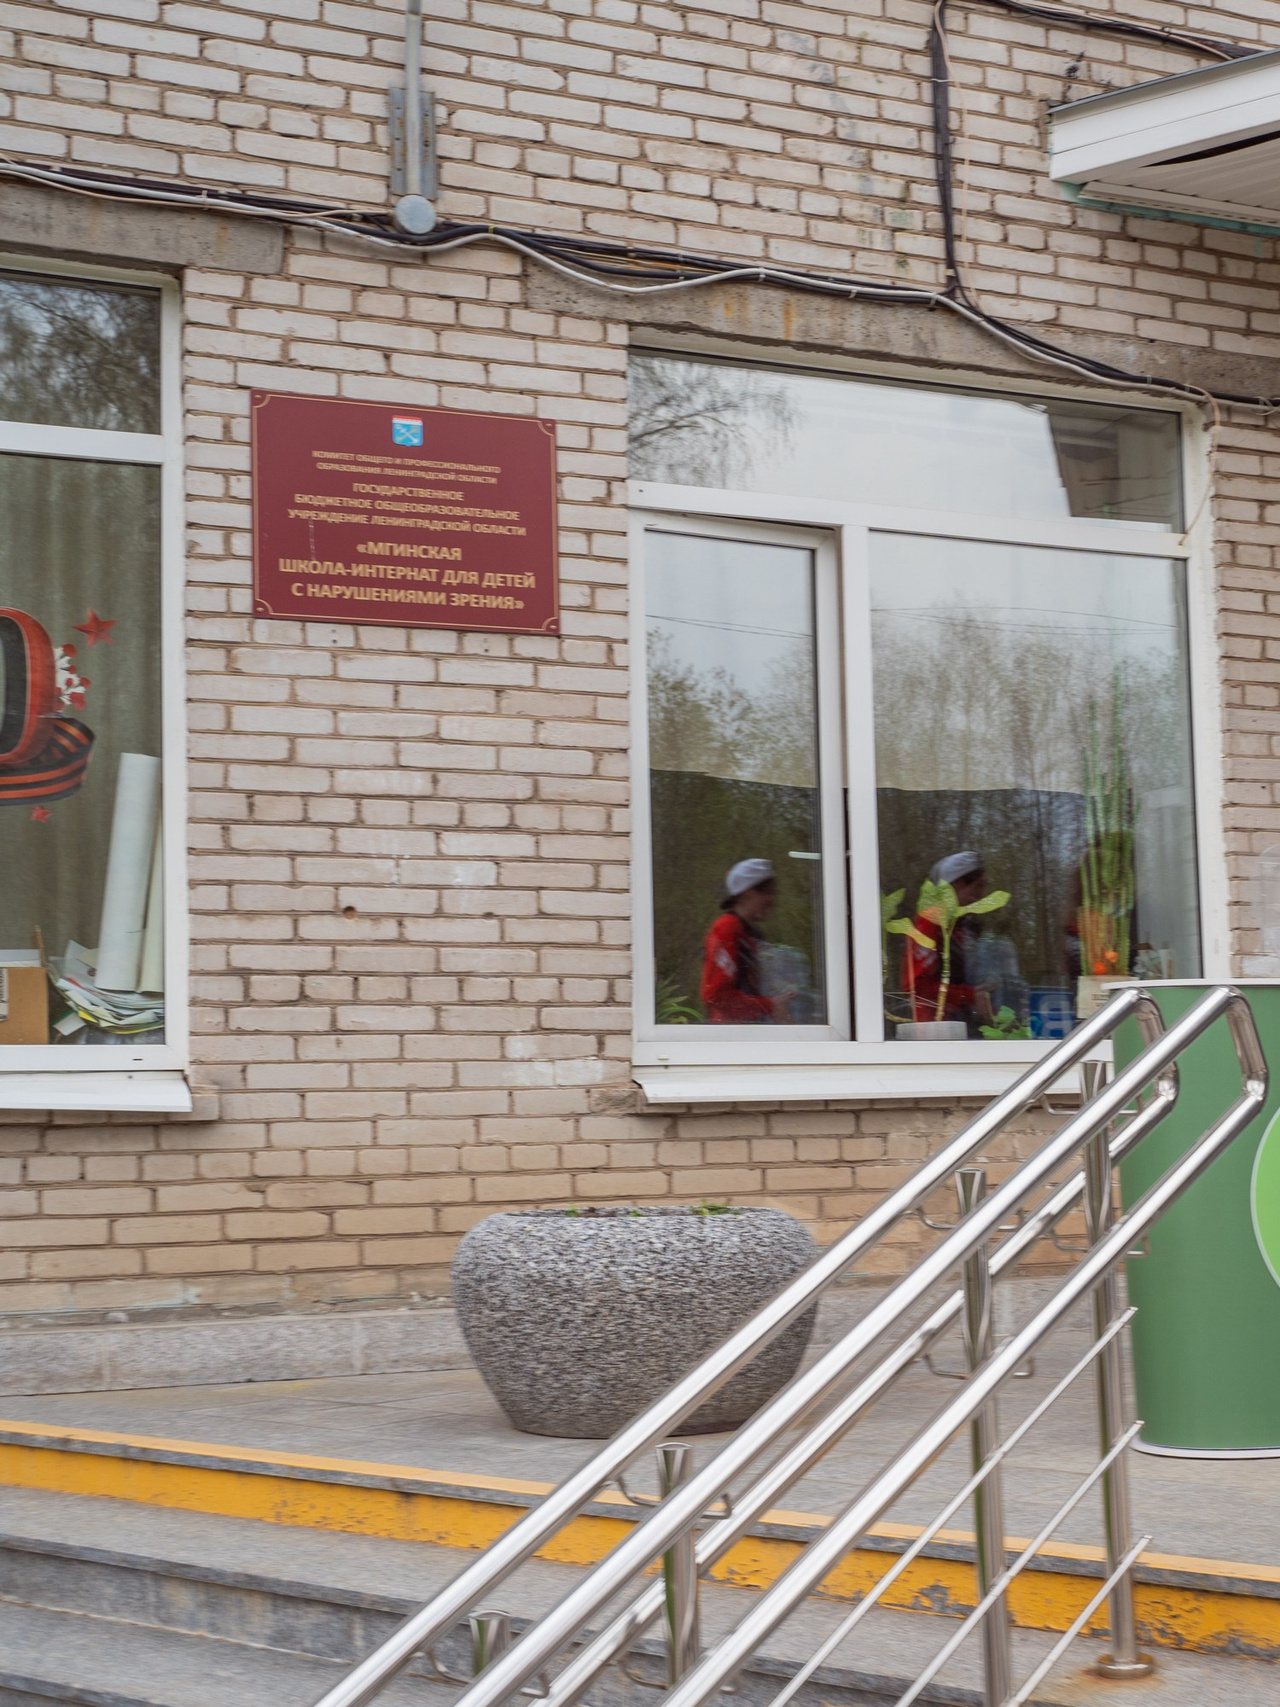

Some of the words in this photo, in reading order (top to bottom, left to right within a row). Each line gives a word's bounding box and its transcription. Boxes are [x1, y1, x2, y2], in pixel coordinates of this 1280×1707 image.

[312, 450, 355, 461] КОМИТЕТ
[356, 454, 393, 465] ОБЩЕГО
[394, 457, 401, 465] И
[402, 457, 501, 473] ПРОФЕССИОНАЛЬНОГО
[316, 462, 381, 475] ОБРАЗОВАНИЯ
[382, 467, 456, 481] ЛЕНИНГРАДСКОЙ
[457, 473, 498, 484] ОБЛАСТИ
[352, 483, 464, 501] ГОСУДАРСТВЕННОЕ
[294, 493, 373, 510] БЮДЖЕТНОЕ
[374, 499, 520, 520] ОБЩЕОБРАЗОВАТЕЛЬНОЕ
[288, 508, 369, 525] УЧРЕЖДЕНИЕ
[370, 514, 471, 532] ЛЕНИНГРАДСКОЙ
[472, 522, 527, 536] ОБЛАСТИ
[356, 541, 462, 561] «МГИНСКАЯ
[279, 558, 439, 582] ШКОЛА-ИНТЕРНАТ
[441, 569, 479, 585] ДЛЯ
[481, 572, 536, 589] ДЕТЕЙ
[291, 582, 305, 597] С
[307, 583, 447, 606] НАРУШЕНИЯМИ
[449, 593, 525, 610] ЗРЕНИЯ»
